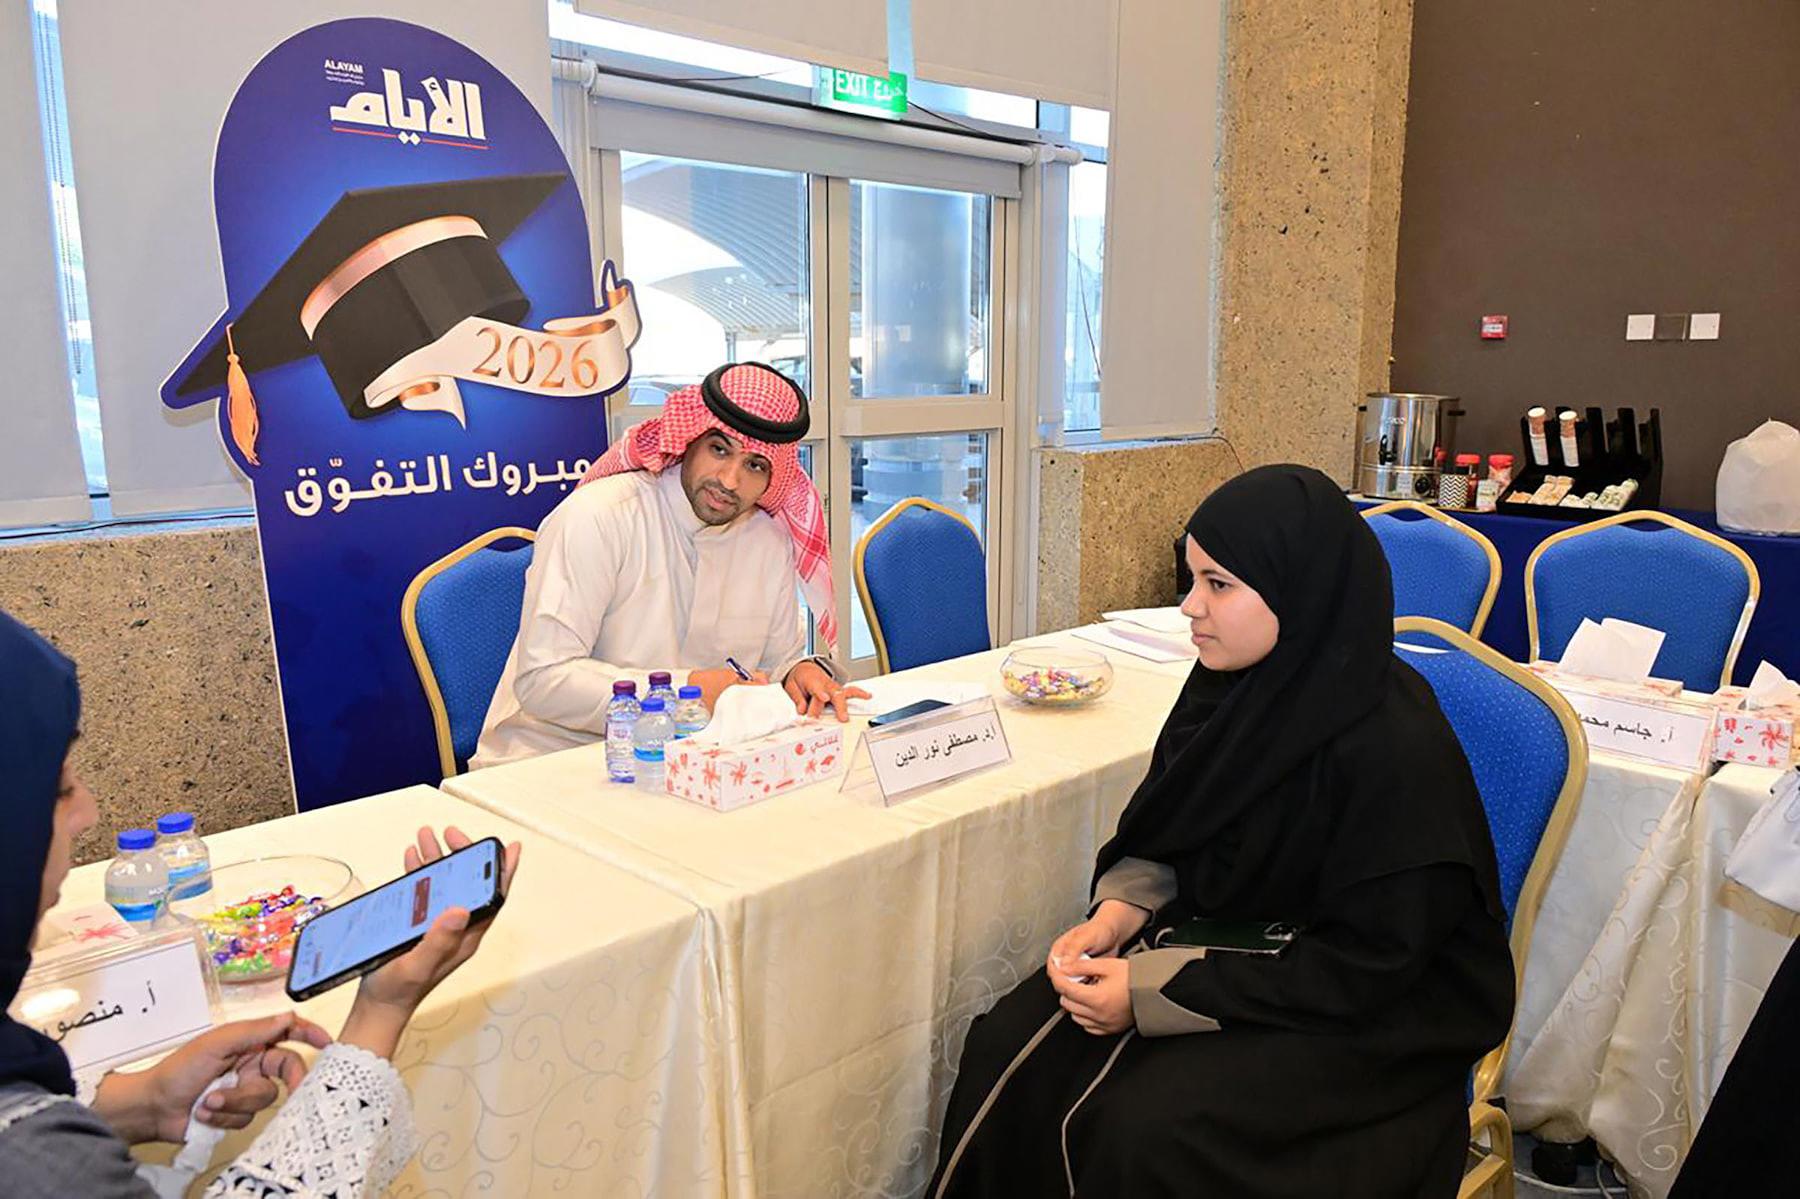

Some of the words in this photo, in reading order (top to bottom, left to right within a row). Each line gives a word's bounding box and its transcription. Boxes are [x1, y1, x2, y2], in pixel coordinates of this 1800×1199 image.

[324, 59, 364, 74] ALAYAM
[836, 69, 868, 96] EXIT
[330, 68, 487, 146] الأيام
[472, 326, 599, 389] 2026
[462, 451, 591, 497] مبروك
[1613, 722, 1652, 740] جاسم
[895, 744, 919, 768] الدين
[923, 739, 939, 760] نور
[943, 733, 978, 757] مصطفى
